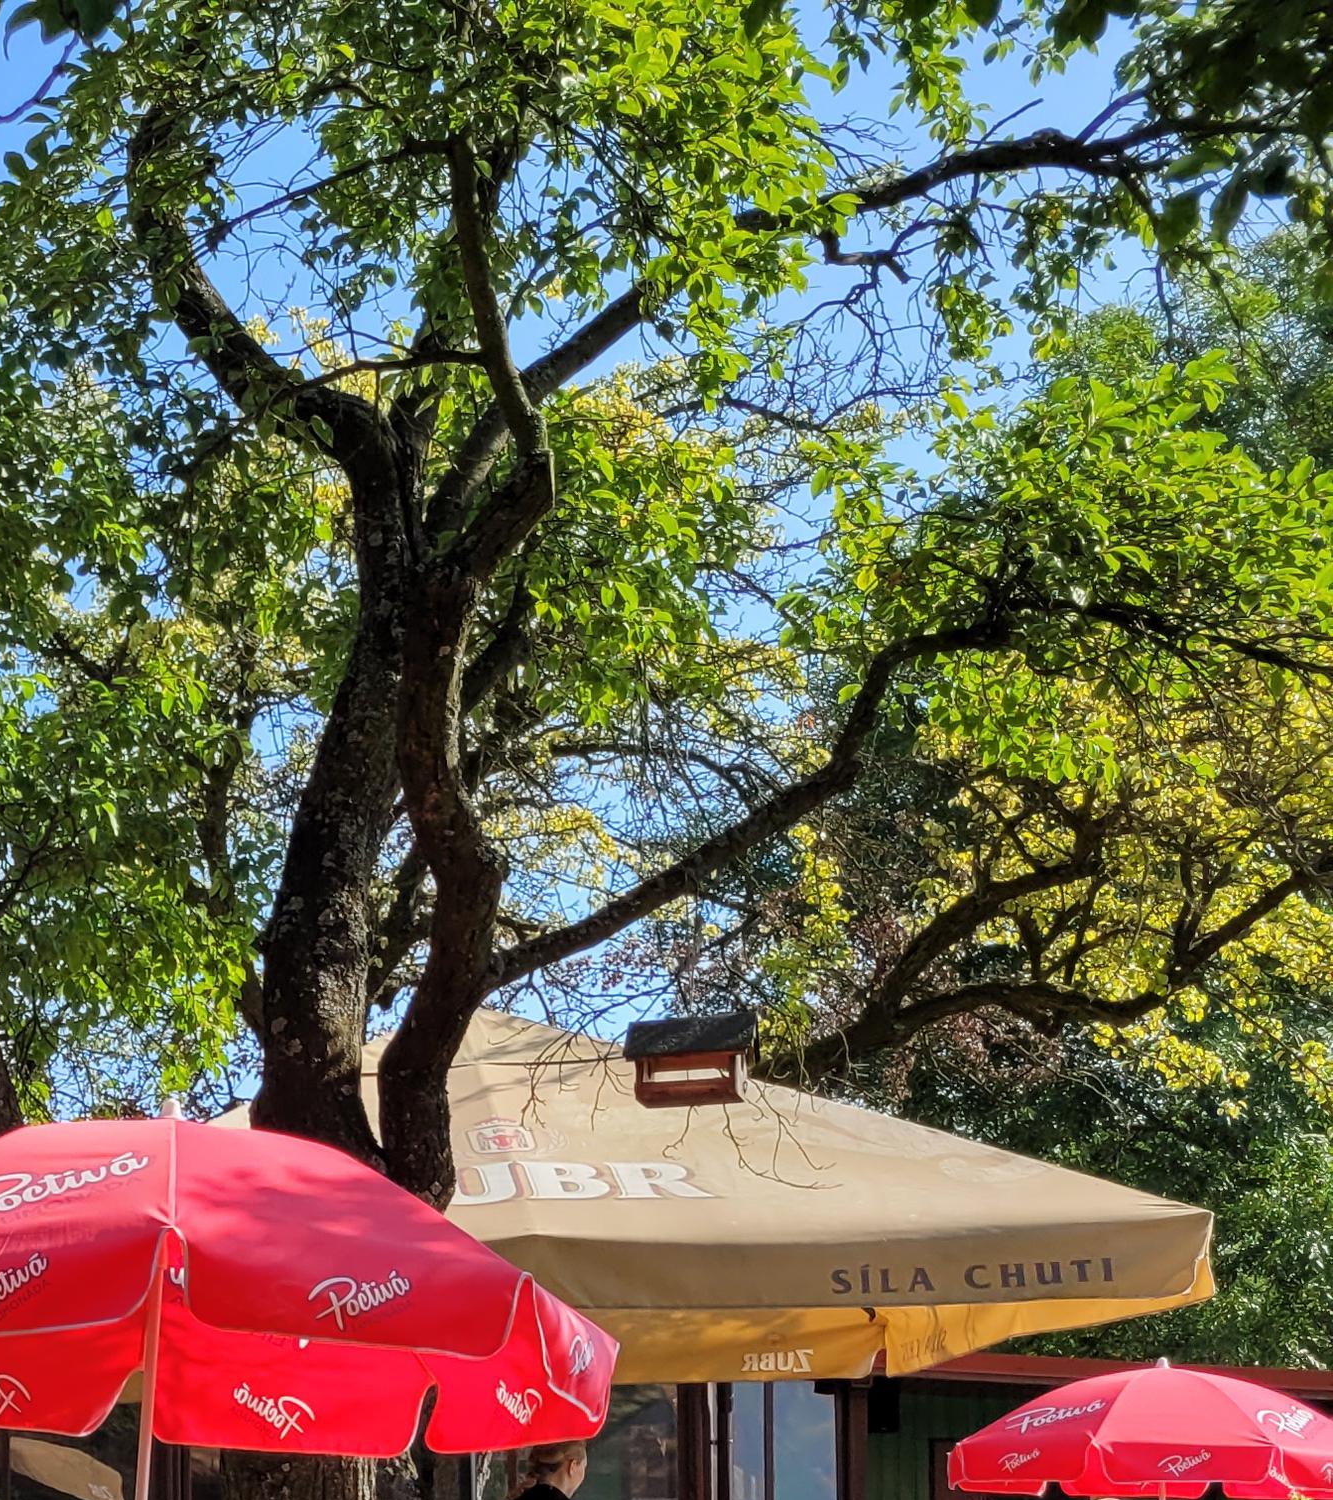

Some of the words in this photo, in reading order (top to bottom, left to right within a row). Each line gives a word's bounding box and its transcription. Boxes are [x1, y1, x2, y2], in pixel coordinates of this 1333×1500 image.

[449, 1160, 722, 1206] UBR
[830, 1263, 936, 1295] SÍLA
[963, 1256, 1114, 1290] CHUTI
[308, 1269, 411, 1332] Poctivá
[1004, 1399, 1107, 1434] Poctivá
[997, 1447, 1041, 1474] Poctivá
[1157, 1448, 1213, 1478] Poctivá
